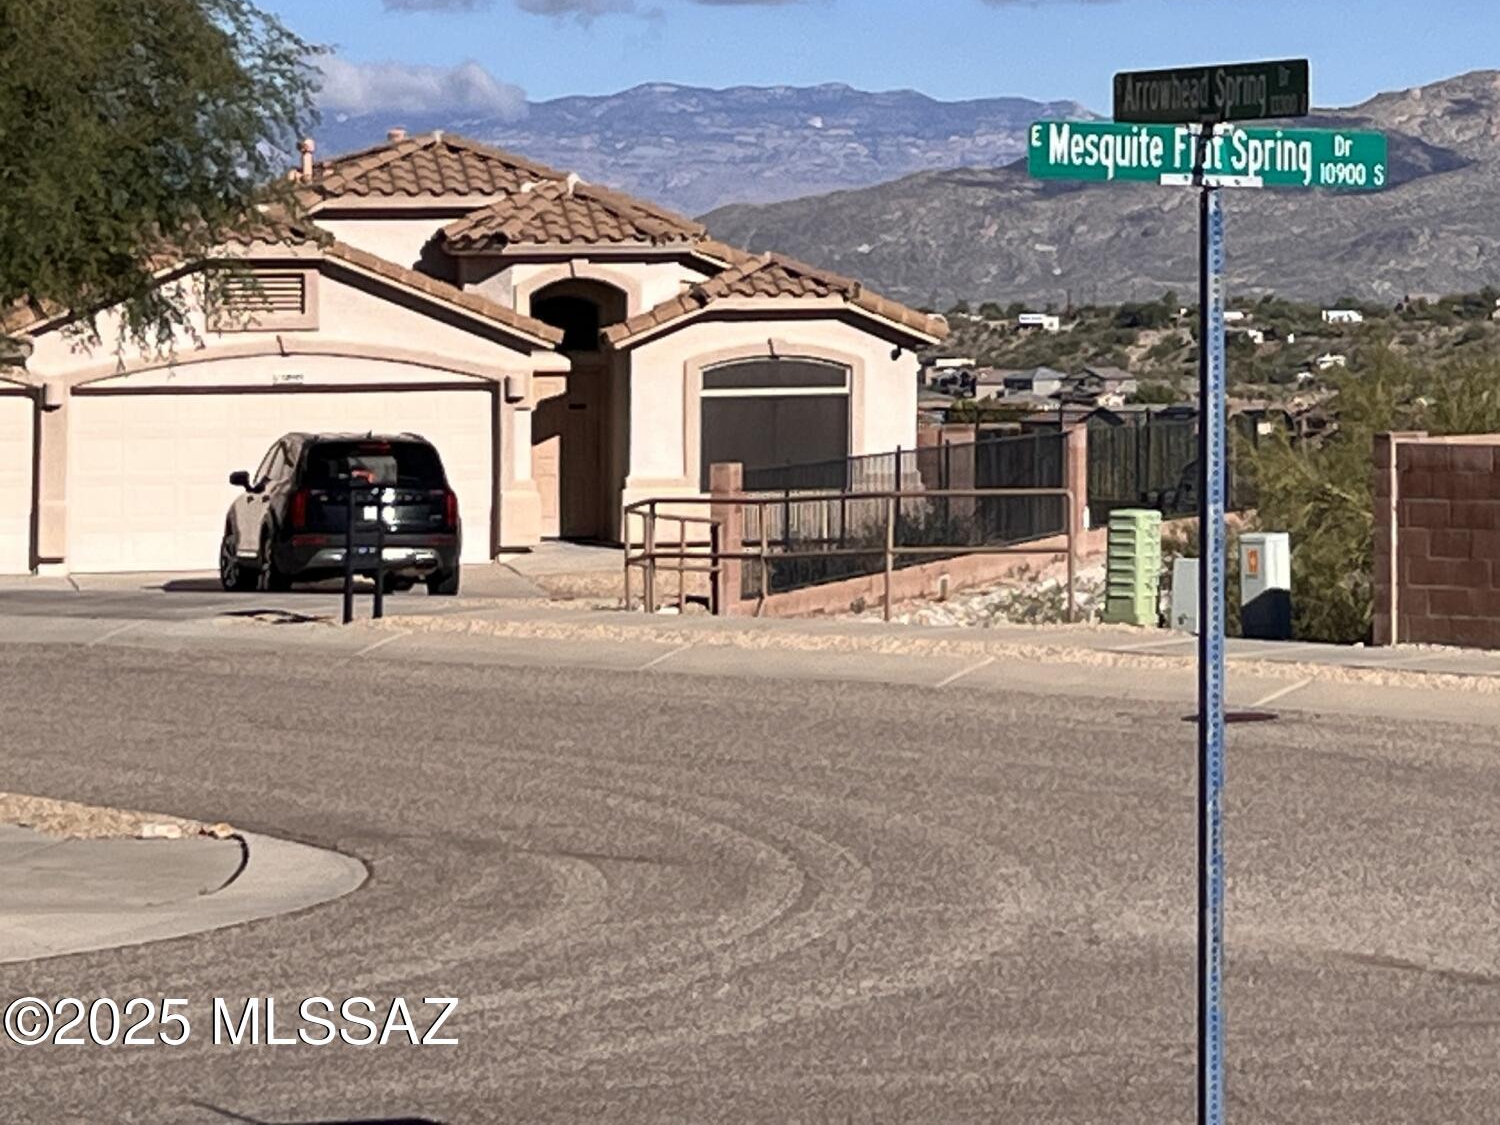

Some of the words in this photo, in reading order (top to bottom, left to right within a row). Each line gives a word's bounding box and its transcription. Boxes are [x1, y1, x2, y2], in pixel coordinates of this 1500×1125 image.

[1123, 69, 1210, 112] Arrowhead
[1213, 67, 1267, 118] Spring
[1031, 125, 1042, 147] E
[1049, 123, 1164, 180] Mesquite
[1230, 129, 1312, 186] Spring
[1334, 135, 1353, 157] Dr
[1320, 163, 1366, 186] 10900
[1374, 164, 1384, 187] S
